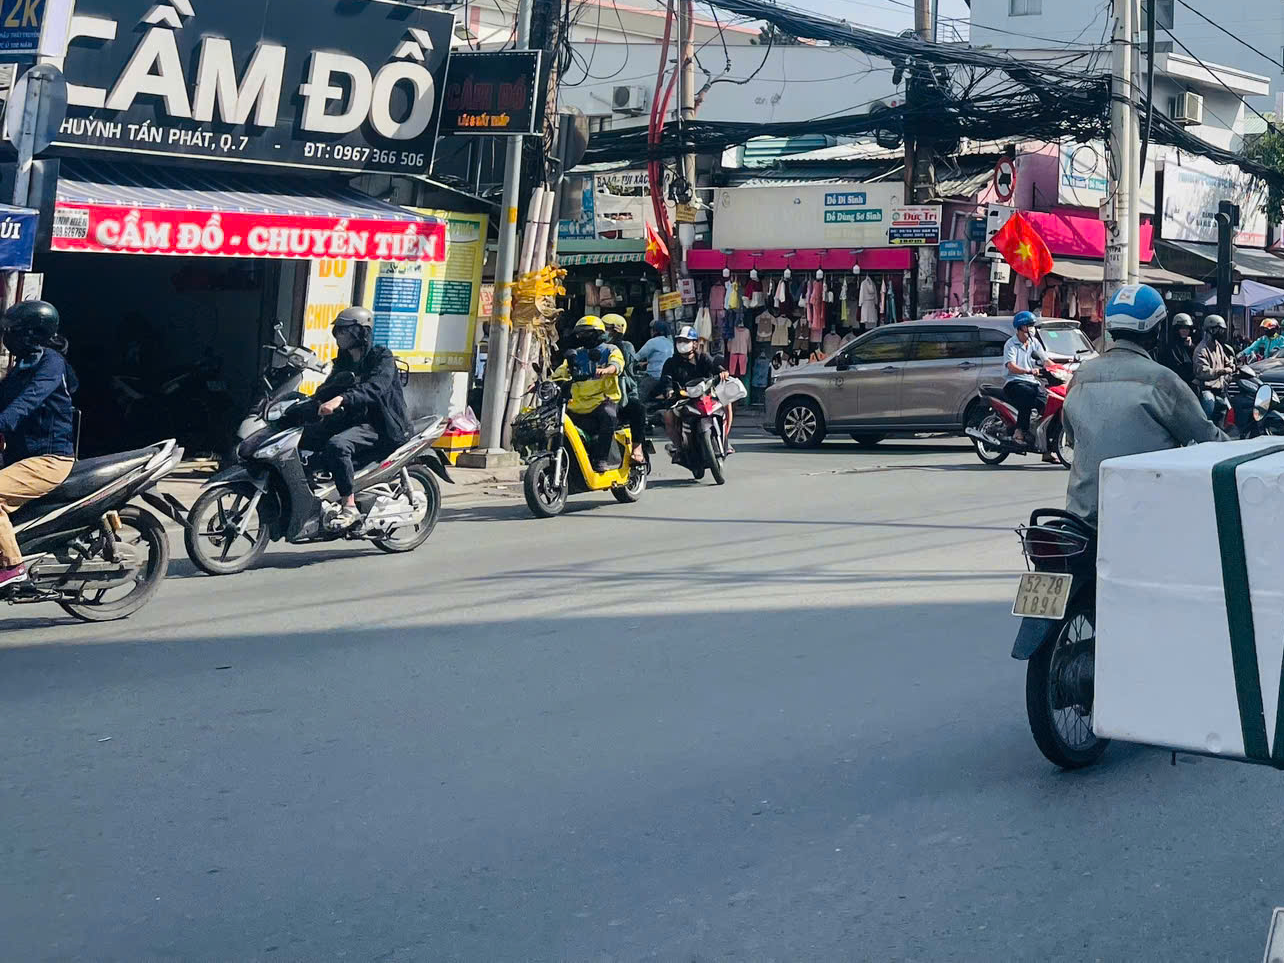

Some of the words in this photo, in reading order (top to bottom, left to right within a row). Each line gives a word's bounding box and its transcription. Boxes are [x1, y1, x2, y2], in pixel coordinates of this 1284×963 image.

[299, 27, 435, 140] ĐỒ
[59, 116, 121, 139] HUỲNH
[128, 120, 161, 143] TẤN
[168, 127, 216, 150] PHÁT,
[333, 145, 370, 161] 0967
[372, 149, 396, 164] 366
[400, 151, 425, 167] 506
[847, 195, 864, 205] Sinh
[865, 210, 882, 220] Sinh
[96, 210, 175, 249] CẦM
[176, 213, 224, 251] ĐỒ
[248, 219, 368, 257] CHUYỂN
[374, 224, 437, 258] TIỀN
[306, 303, 346, 330] CHUY
